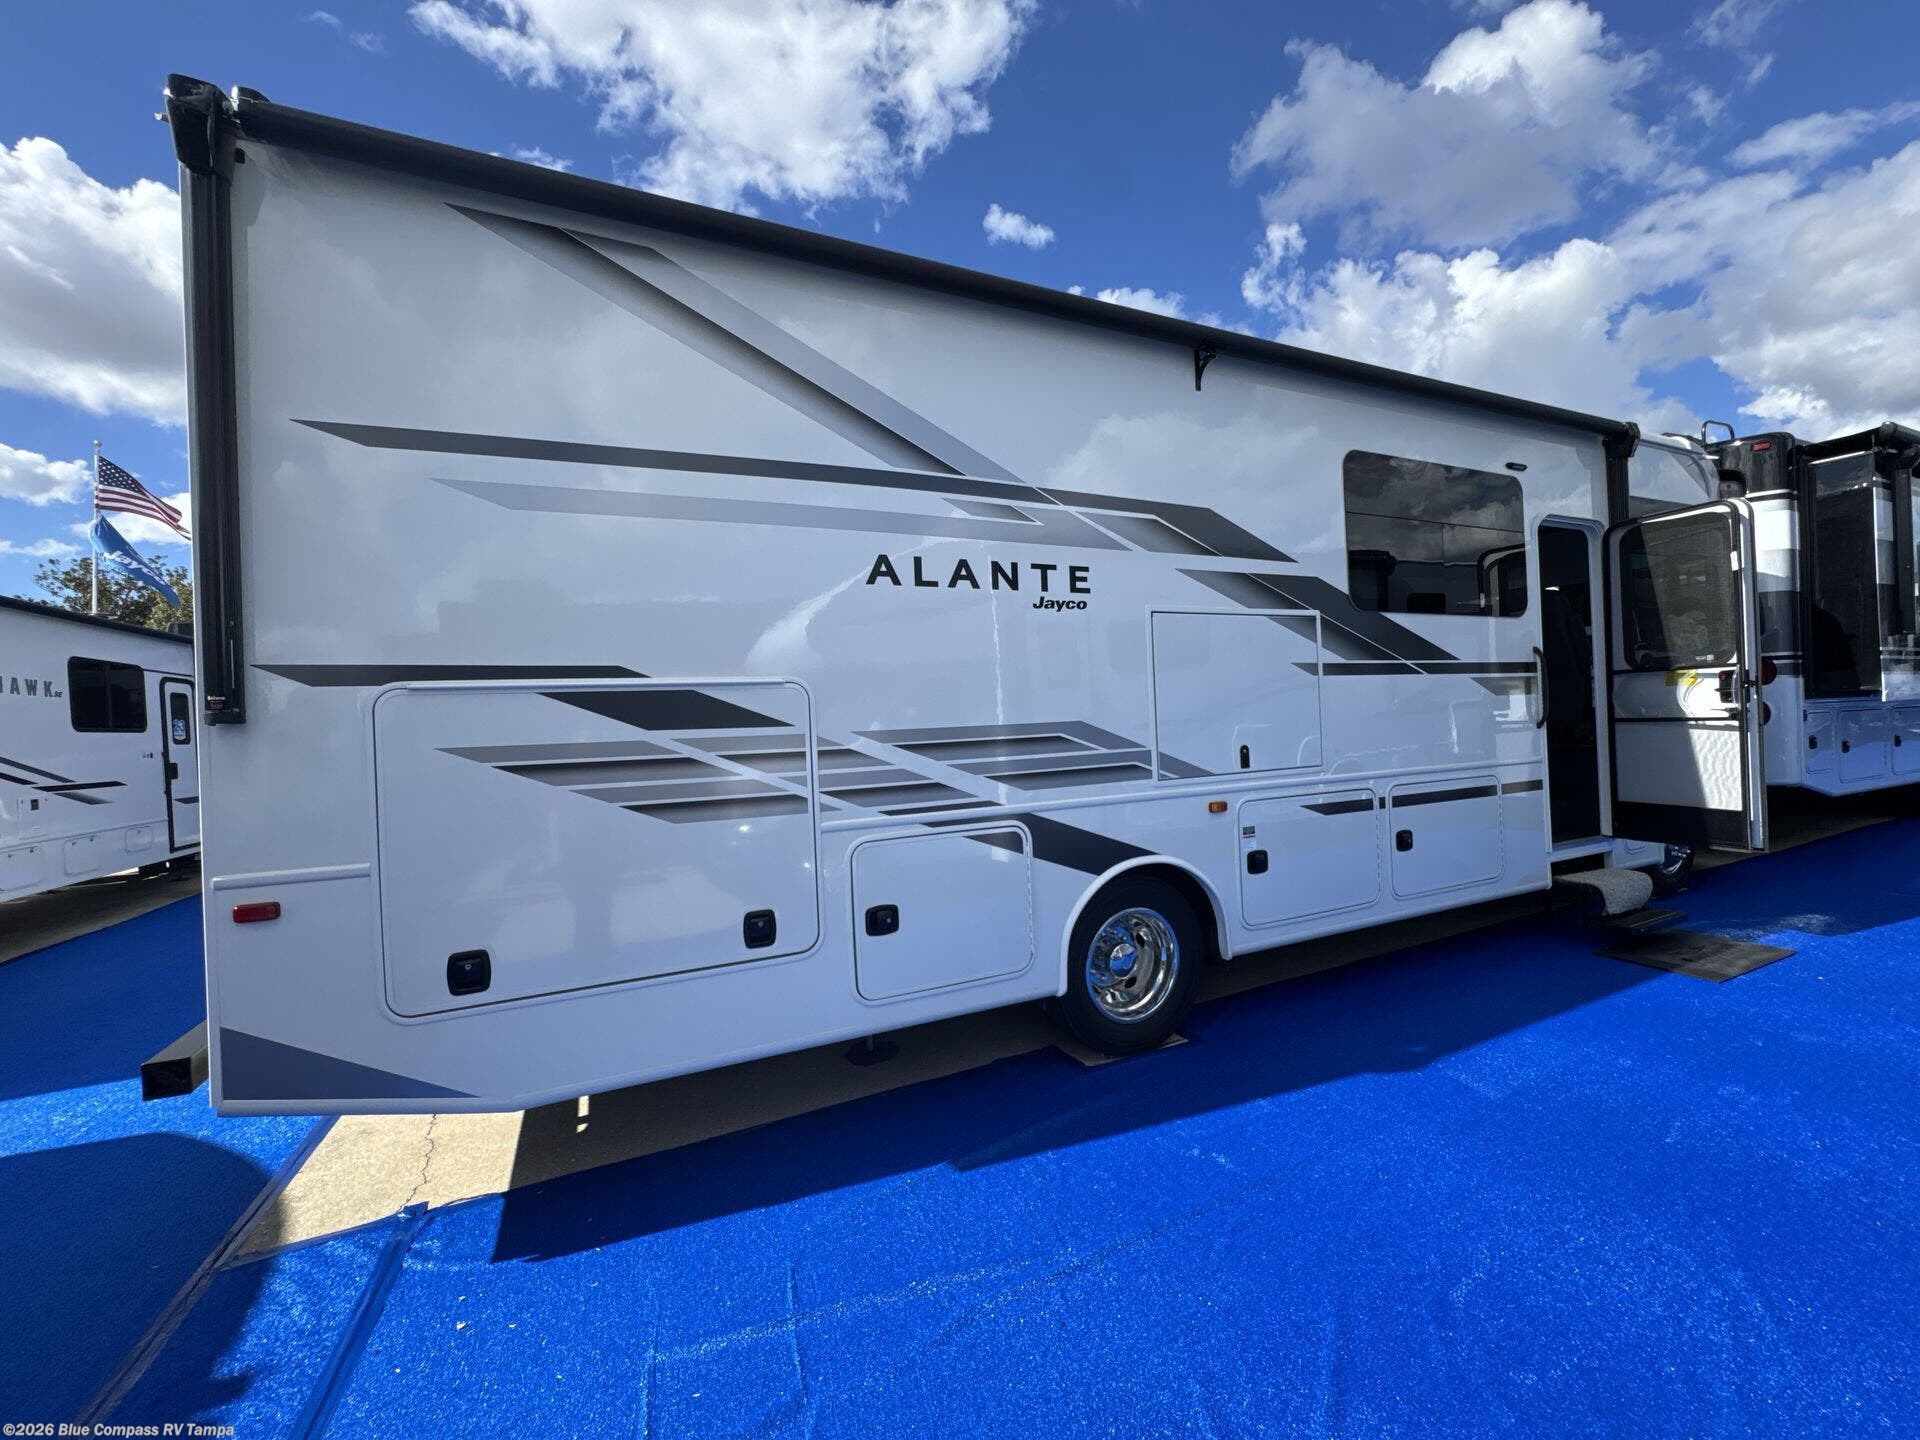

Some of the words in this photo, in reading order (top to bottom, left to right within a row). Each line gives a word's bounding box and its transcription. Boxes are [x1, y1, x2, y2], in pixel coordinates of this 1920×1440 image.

[865, 554, 1091, 594] ALANTE
[1032, 596, 1088, 613] Jayco
[0, 675, 53, 698] AWK
